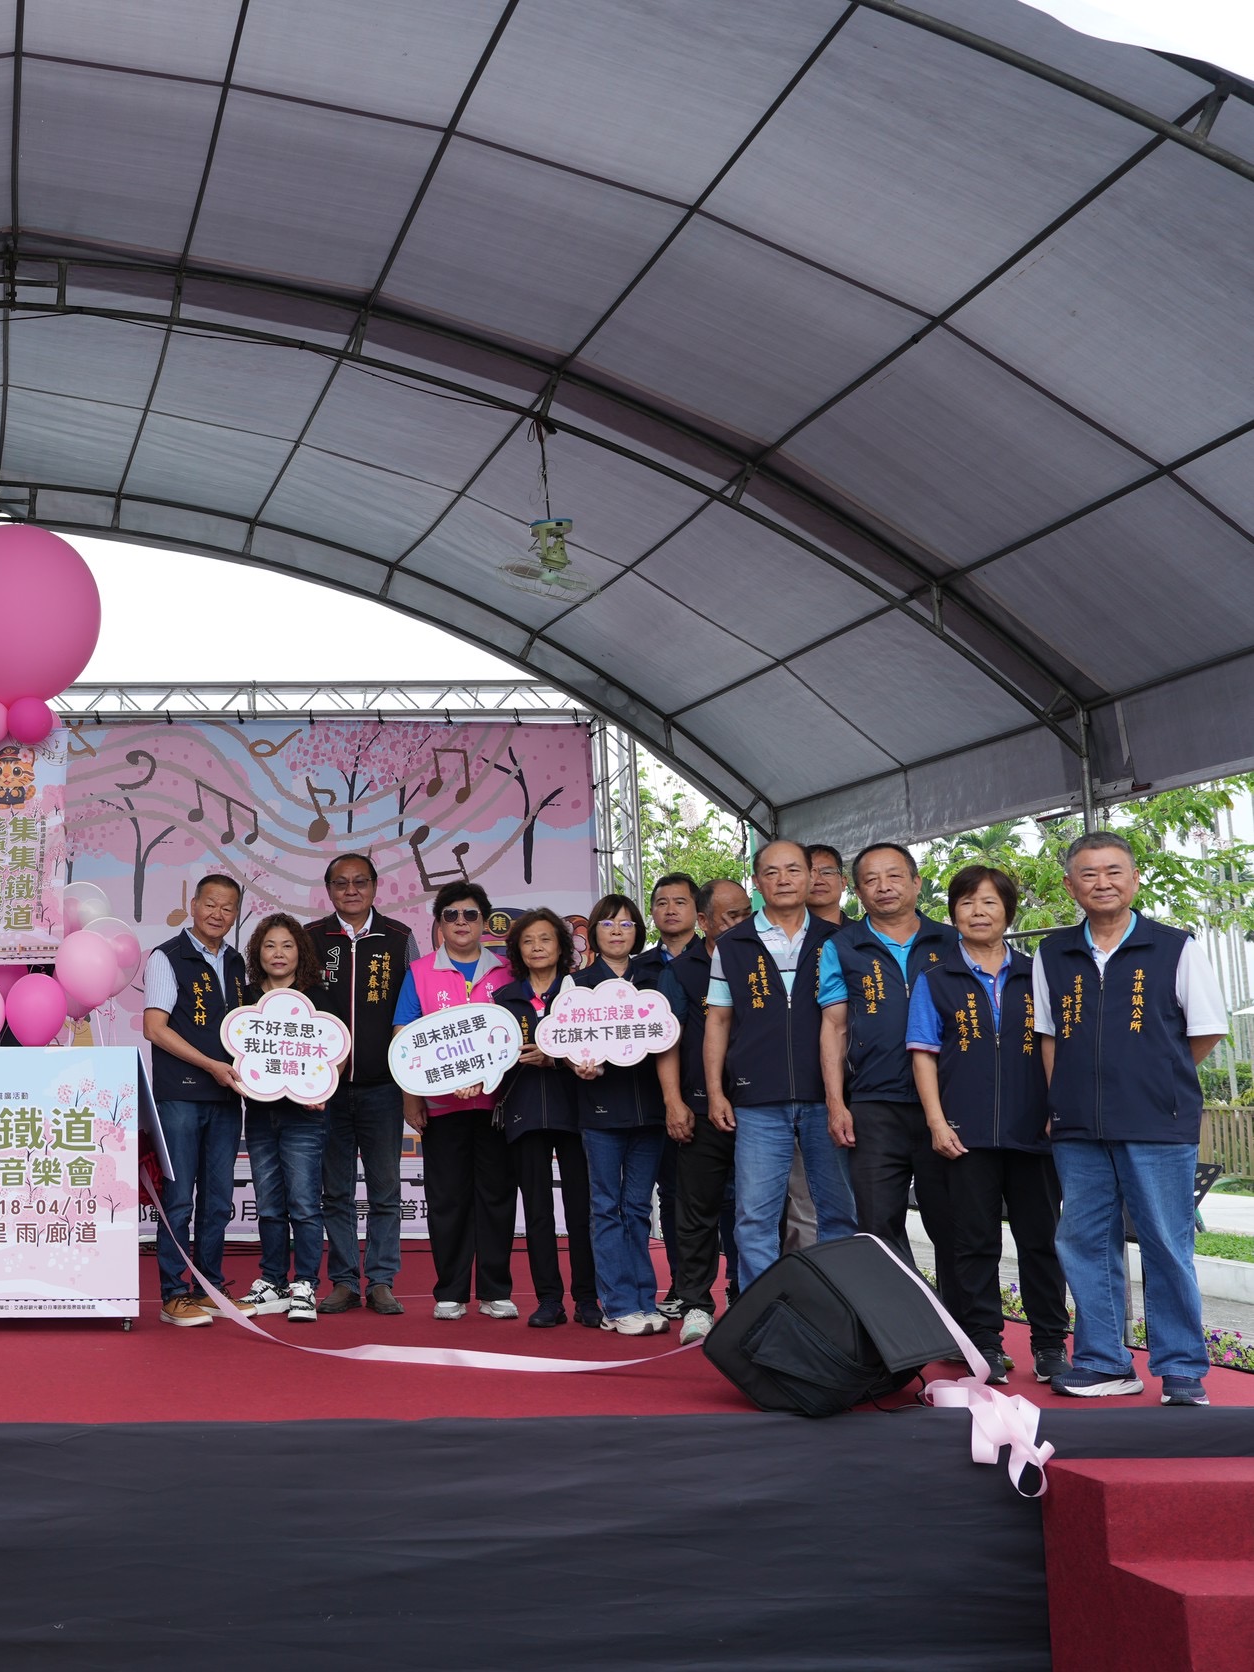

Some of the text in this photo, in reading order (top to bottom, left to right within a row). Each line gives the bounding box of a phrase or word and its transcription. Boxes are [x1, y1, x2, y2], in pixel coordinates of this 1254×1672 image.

[4, 816, 40, 931] 集集鐵道
[492, 916, 507, 931] 集
[201, 971, 213, 993] 鎮長
[326, 945, 341, 983] FILA
[381, 951, 391, 1000] 南投縣議員
[192, 981, 207, 1026] 吳大村
[570, 1004, 635, 1024] 粉紅浪漫
[1073, 974, 1083, 1024] 集集里里長
[1129, 969, 1146, 1034] 集集鎮公所
[411, 1014, 488, 1050] 週末就是要
[552, 1022, 665, 1045] 花旗木下聽音樂
[954, 1009, 971, 1052] 陳秀雪
[1022, 993, 1035, 1056] 集集鎮公所
[244, 1038, 328, 1059] 我比花旗木
[435, 1037, 476, 1062] Chill
